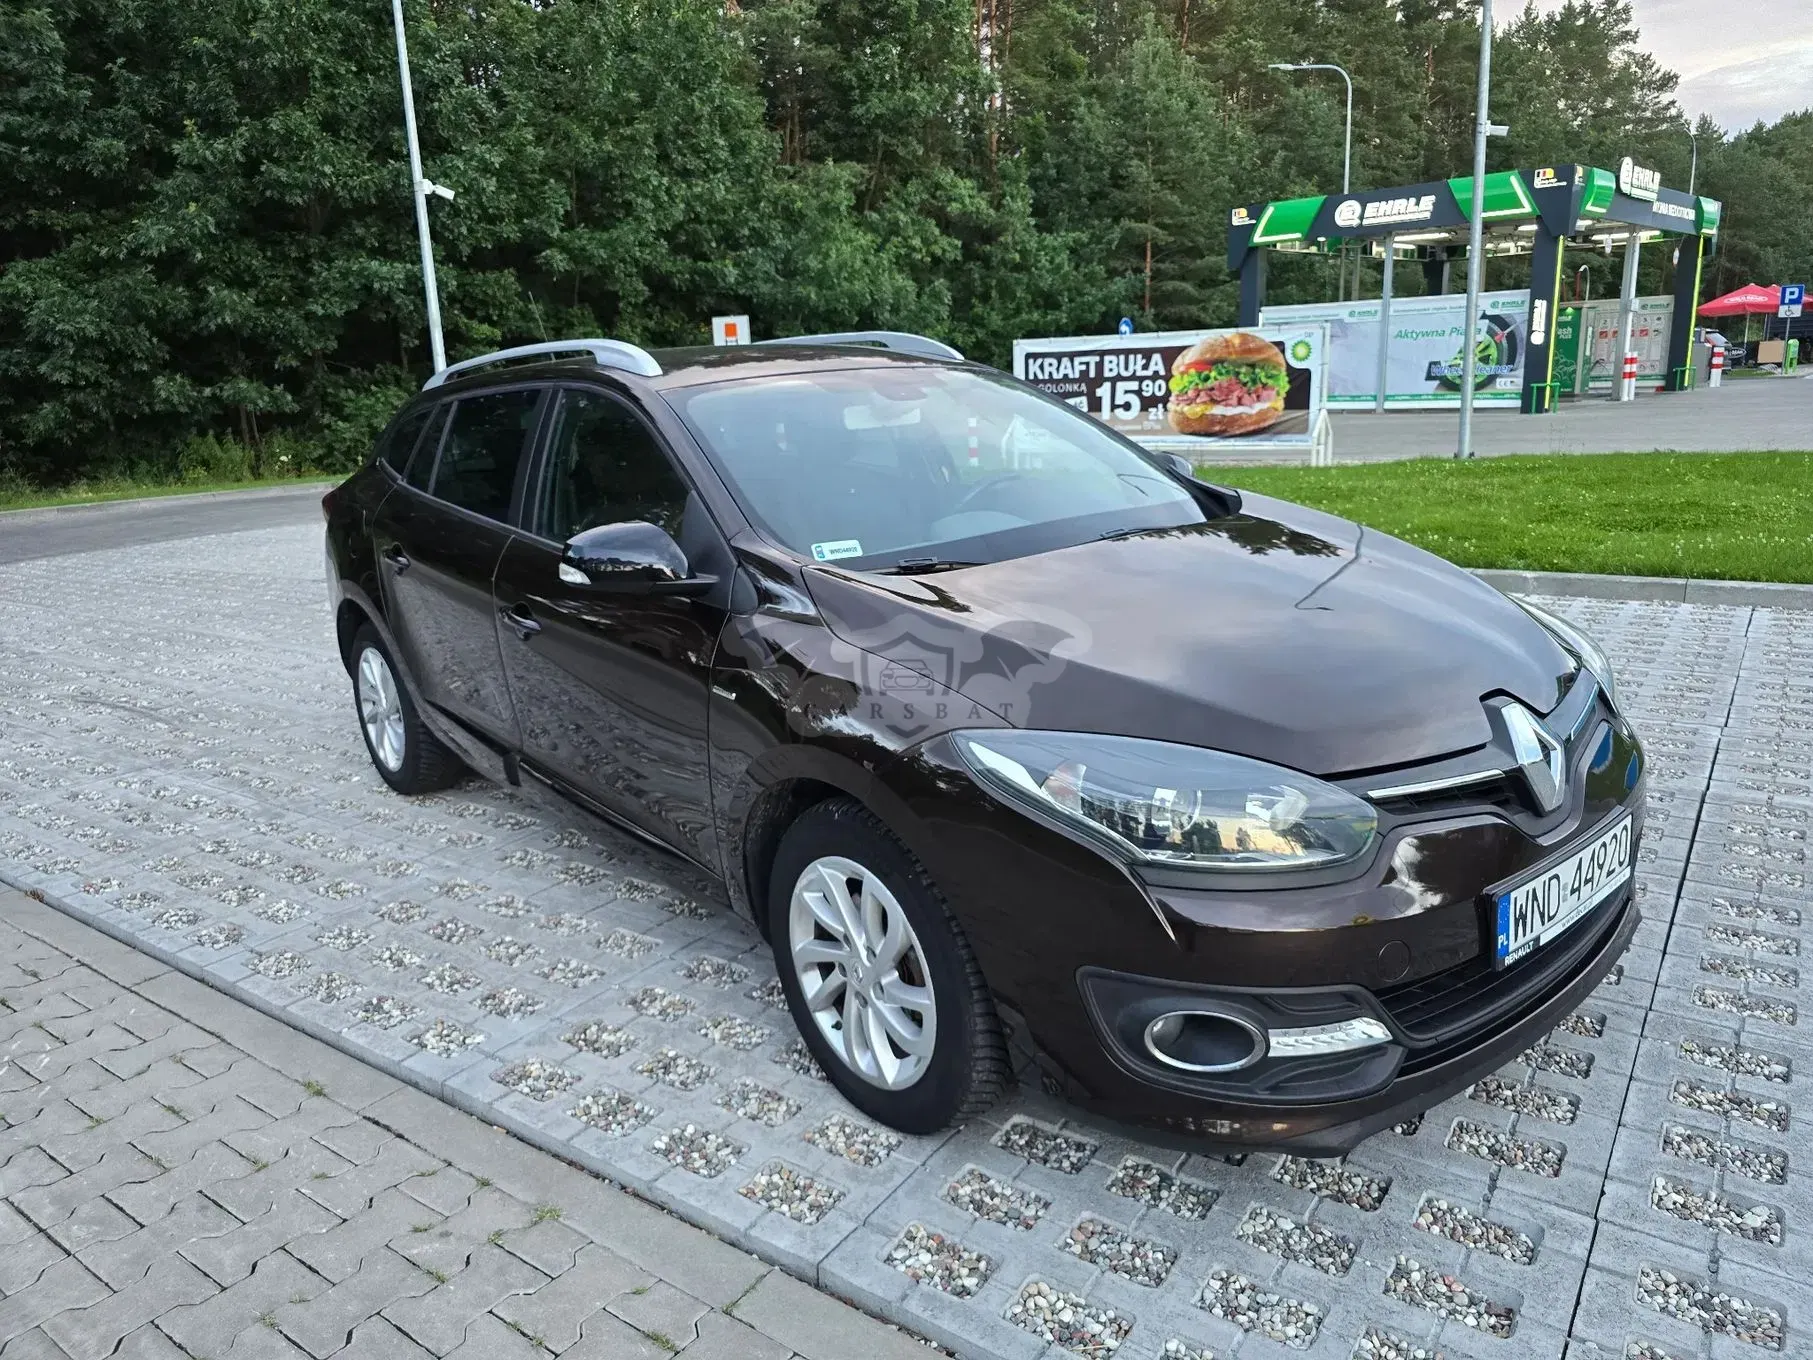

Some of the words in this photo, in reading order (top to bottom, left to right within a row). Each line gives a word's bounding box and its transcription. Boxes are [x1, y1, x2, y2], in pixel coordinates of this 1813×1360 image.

[1632, 166, 1661, 192] EHRLE
[1364, 195, 1436, 219] EHRLE
[1784, 287, 1800, 304] P
[1394, 327, 1445, 342] Aktywna
[1449, 326, 1482, 337] Piaa
[1028, 356, 1100, 380] KRAFT
[1103, 353, 1166, 378] BUŁA
[1431, 364, 1465, 377] Whee
[1475, 364, 1514, 375] leaner
[1096, 381, 1141, 421] 15
[1141, 379, 1167, 397] 90
[1148, 403, 1165, 420] zł
[1514, 873, 1561, 943] WND
[1569, 824, 1629, 902] 44920
[1498, 932, 1508, 949] PL
[1505, 941, 1534, 967] RENAULT
